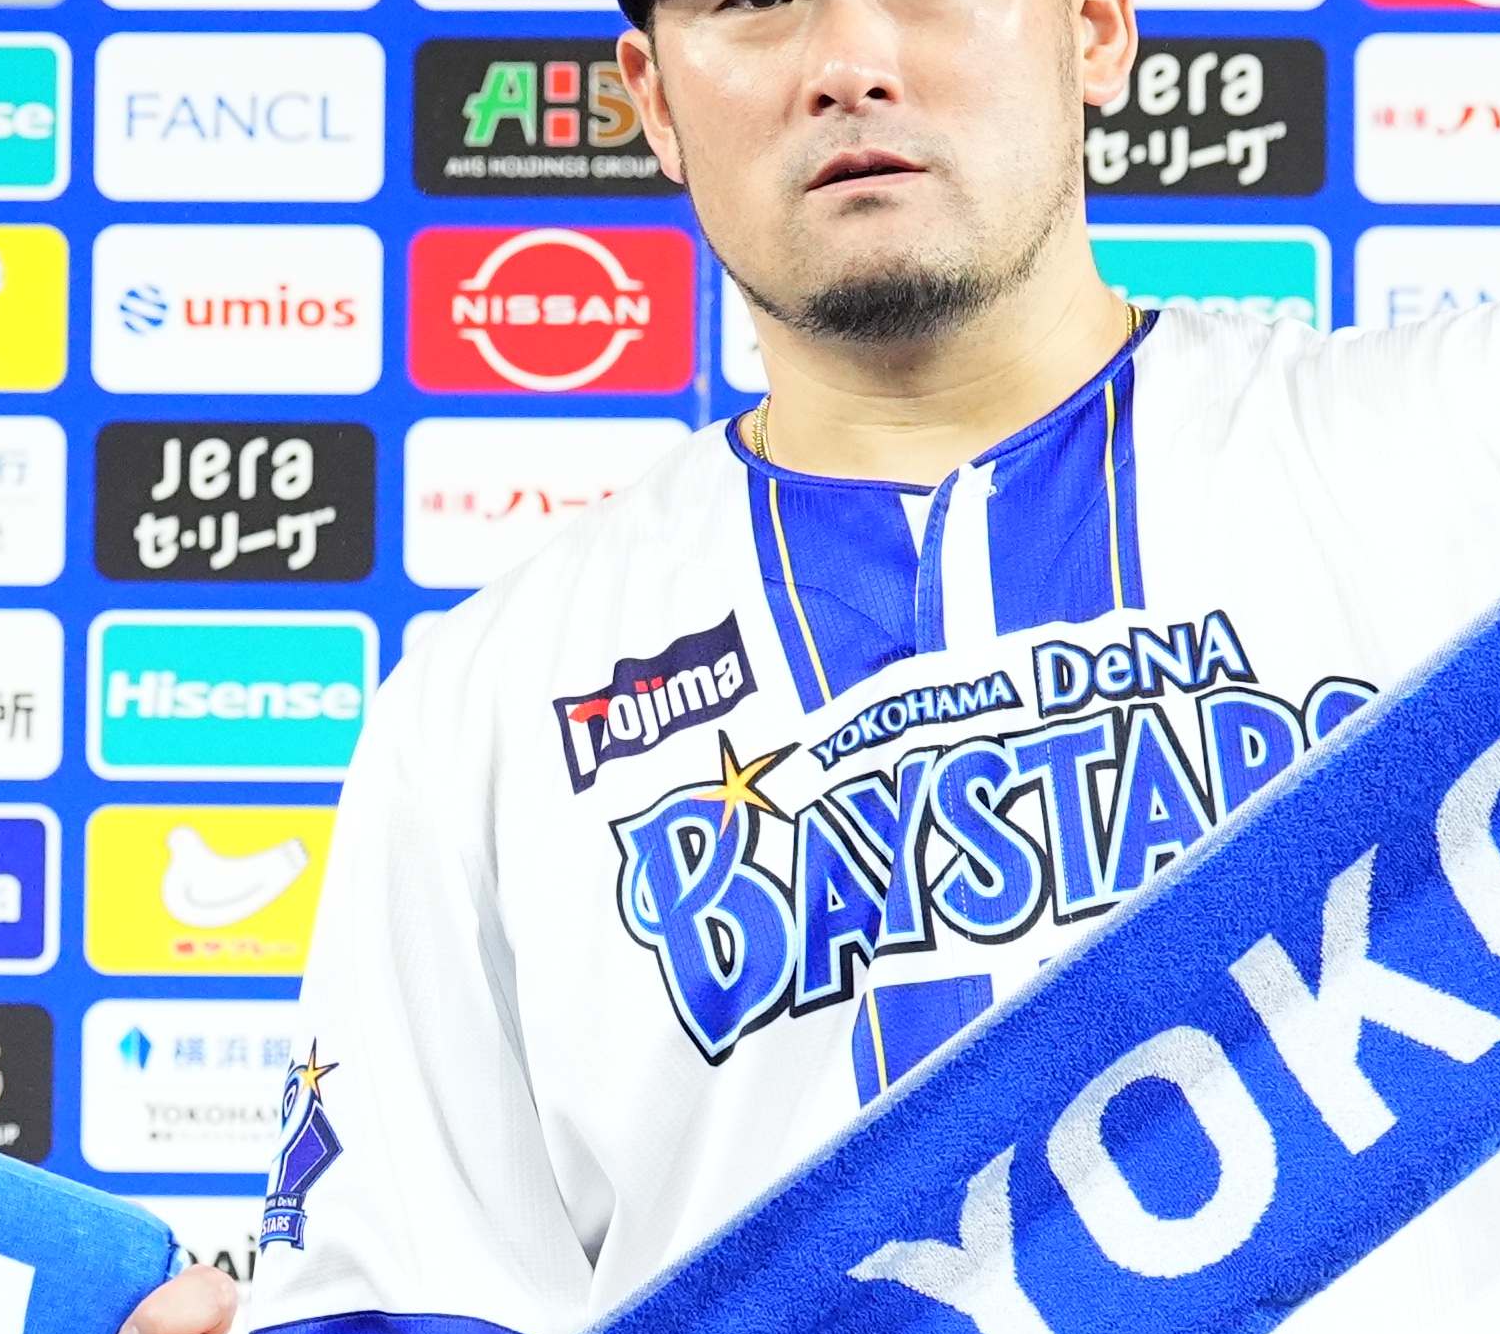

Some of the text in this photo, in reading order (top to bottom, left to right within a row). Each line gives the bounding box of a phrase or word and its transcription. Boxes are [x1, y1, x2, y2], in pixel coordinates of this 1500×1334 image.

[124, 92, 350, 142] FANCL
[185, 285, 356, 327] umios
[807, 610, 1258, 770] YOKOHAMA DeNA
[261, 1215, 291, 1236] STARS
